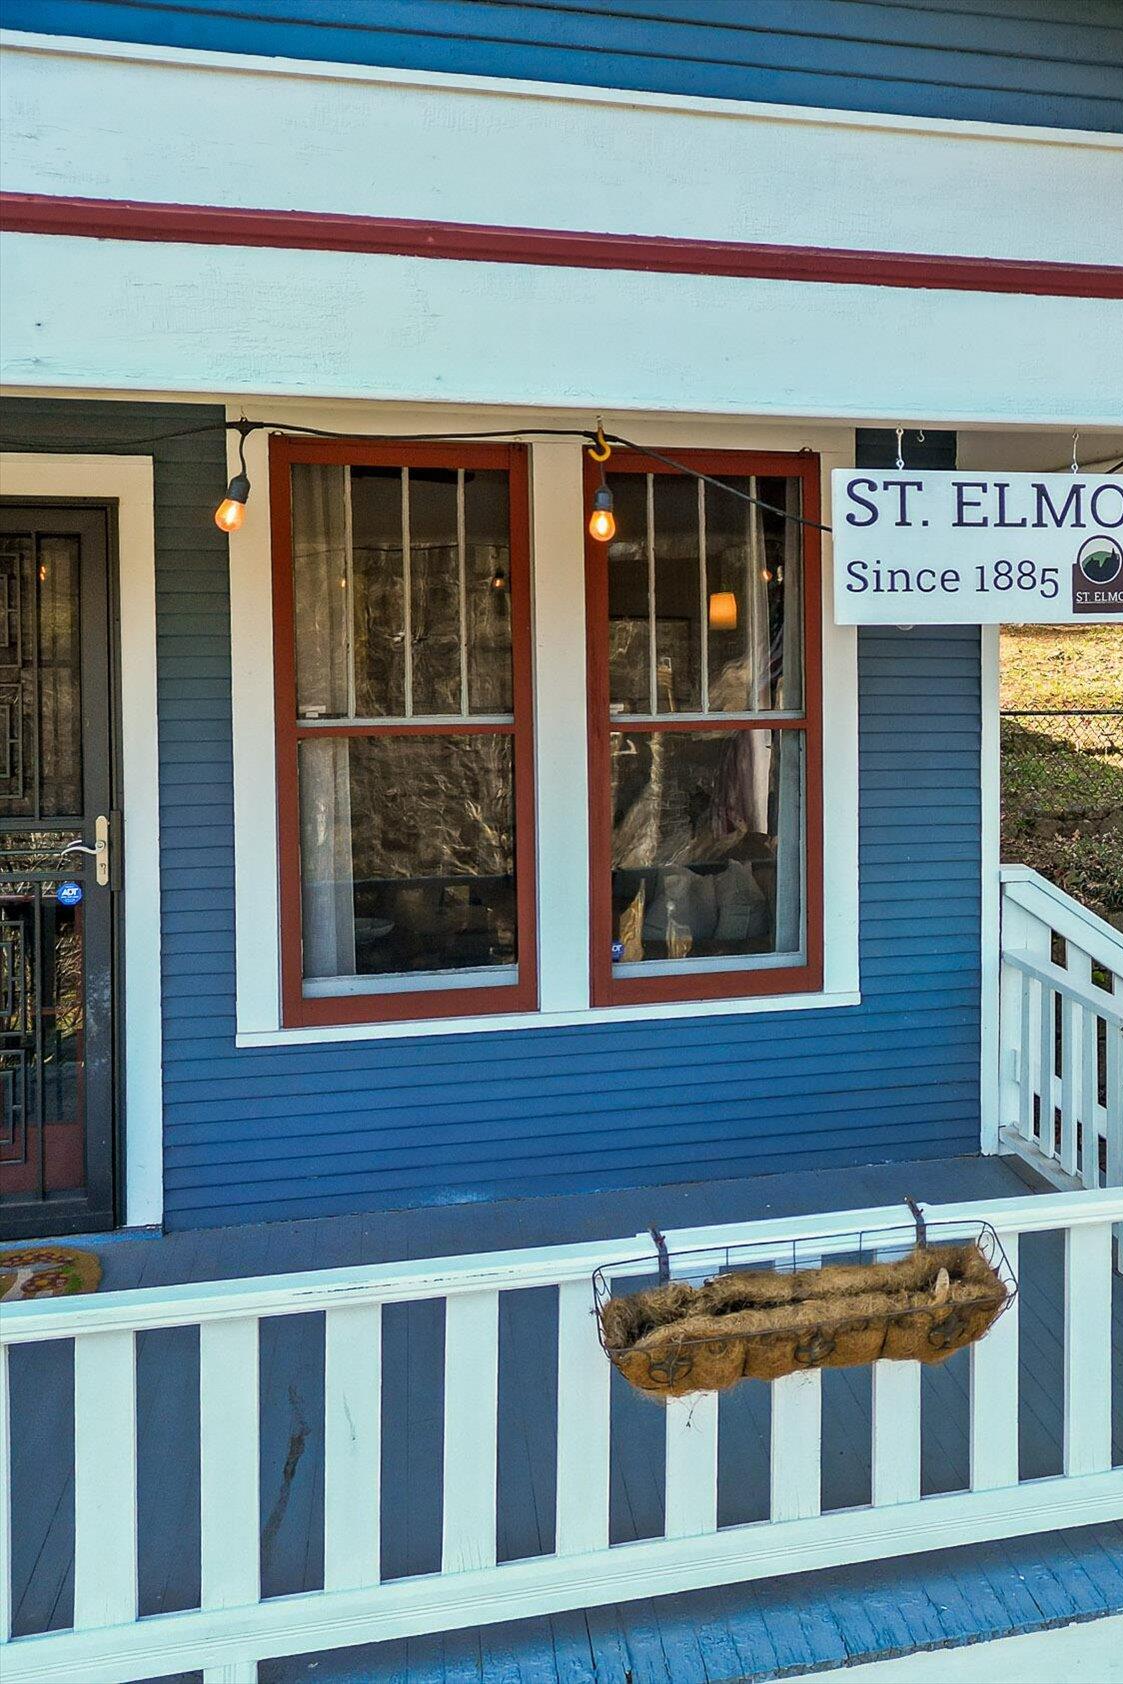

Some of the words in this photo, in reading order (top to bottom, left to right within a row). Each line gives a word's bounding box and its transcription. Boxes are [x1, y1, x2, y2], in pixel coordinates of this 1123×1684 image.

[846, 478, 929, 527] ST.
[846, 560, 960, 593] Since
[975, 560, 1060, 598] 1885
[62, 888, 78, 896] ADT
